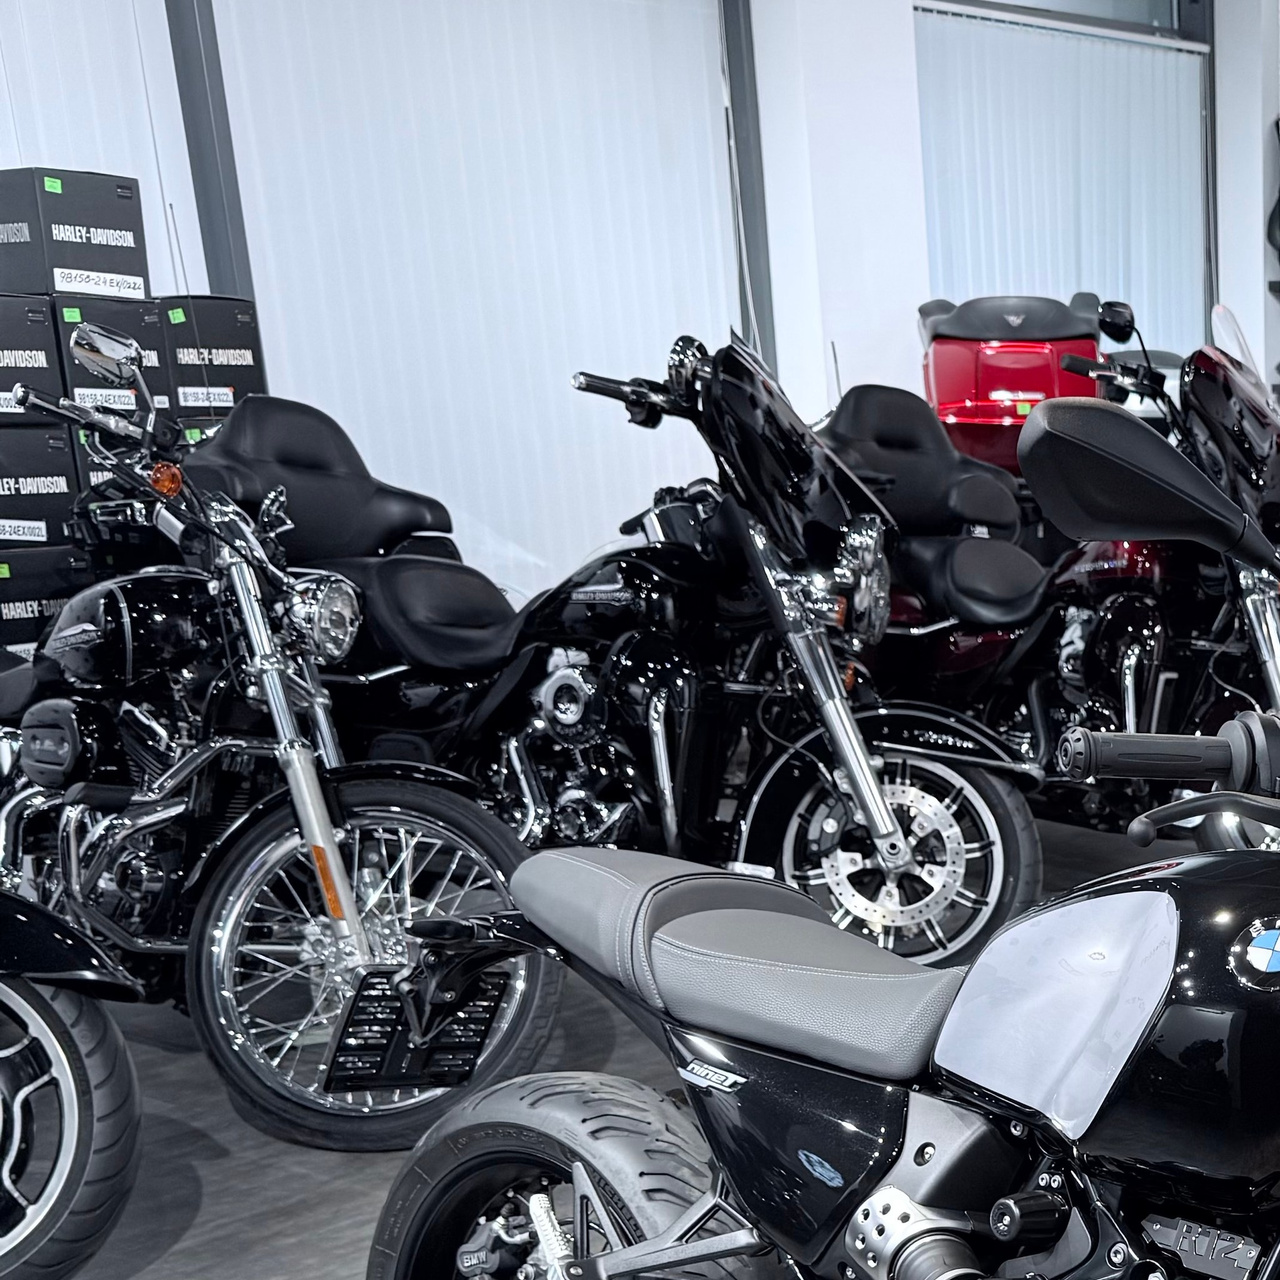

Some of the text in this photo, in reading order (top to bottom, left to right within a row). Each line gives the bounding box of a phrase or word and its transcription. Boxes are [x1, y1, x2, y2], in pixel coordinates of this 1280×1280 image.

[51, 223, 135, 248] HARLEY-DAVIDSON
[176, 348, 254, 366] HARLEY-DAVIDSON
[686, 1063, 748, 1088] nineT
[463, 1250, 486, 1267] BMW
